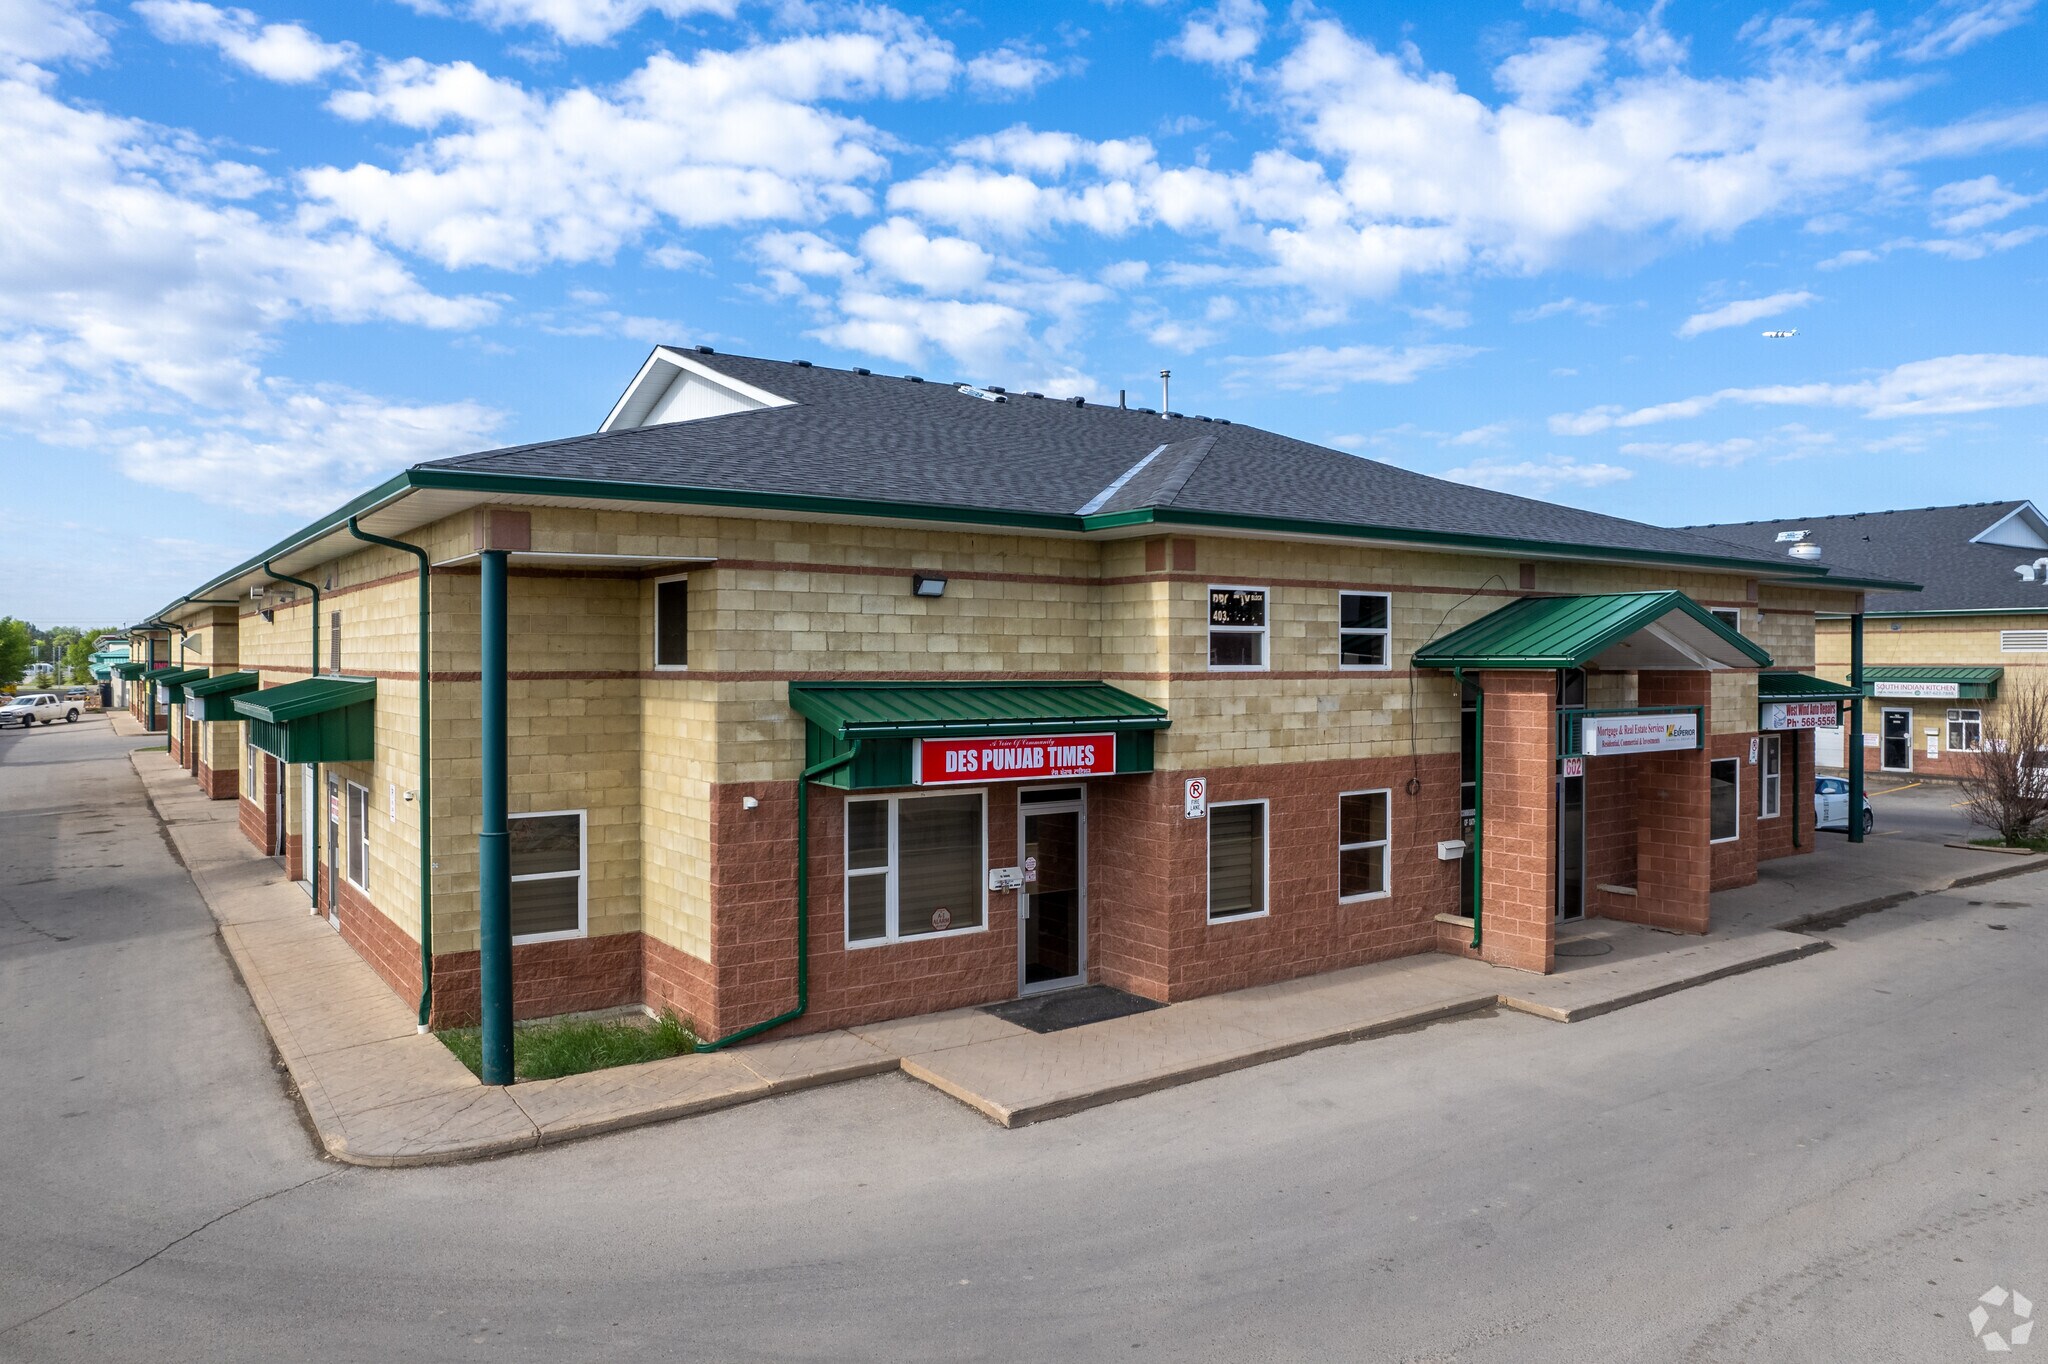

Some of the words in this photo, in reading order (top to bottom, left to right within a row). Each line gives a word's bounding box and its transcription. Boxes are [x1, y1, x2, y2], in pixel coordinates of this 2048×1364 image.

[1786, 704, 1797, 716] West
[1798, 704, 1809, 715] Wind
[1810, 704, 1819, 715] Auto
[1820, 703, 1835, 715] Repairs
[1802, 717, 1835, 726] 568-5556
[1597, 726, 1618, 738] Mortgage
[1619, 724, 1623, 734] &
[1624, 724, 1634, 734] Real
[1635, 724, 1647, 734] Estate
[1648, 723, 1665, 733] Services
[1674, 728, 1696, 736] EXPERIOR
[946, 749, 978, 772] DES
[982, 747, 1044, 770] PUNJAB
[1047, 745, 1094, 767] TIMES
[1567, 758, 1581, 775] 602
